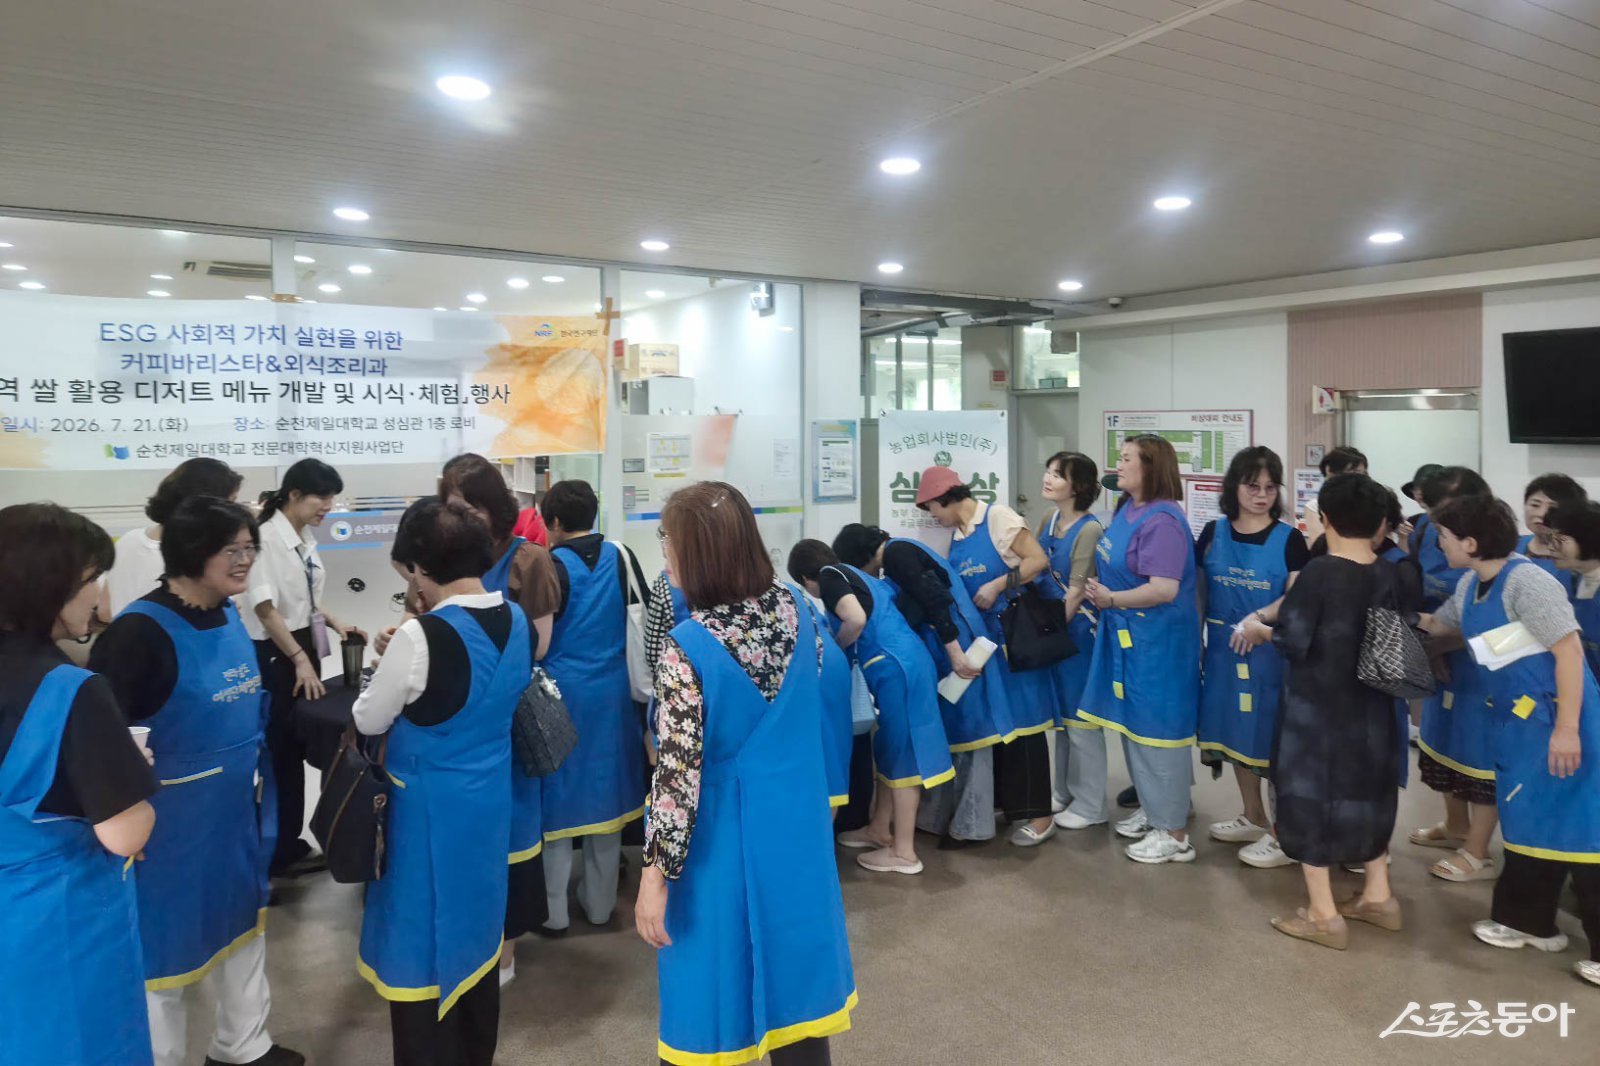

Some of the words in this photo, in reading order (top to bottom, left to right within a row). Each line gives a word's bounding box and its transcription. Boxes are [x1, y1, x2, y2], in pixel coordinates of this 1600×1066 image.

[99, 322, 157, 343] ESG
[167, 324, 236, 345] 사회적
[243, 324, 287, 346] 가치
[295, 326, 357, 349] 실현을
[363, 329, 404, 351] 위한
[120, 352, 388, 377] 커피바리스타&외식조리과
[30, 378, 58, 404] 쌀
[68, 379, 125, 404] 활용
[135, 380, 215, 404] 디저트
[223, 381, 272, 404] 메뉴
[279, 381, 326, 404] 개발
[334, 382, 354, 404] 및
[0, 416, 43, 433] 일시:
[50, 417, 105, 433] 2026.
[111, 418, 127, 433] 7.
[133, 416, 189, 433] 21.(화)
[232, 417, 270, 432] 장소:
[275, 417, 378, 432] 순천제일대학교
[383, 417, 425, 431] 성심관
[428, 417, 447, 431] 1층
[450, 417, 476, 431] 로비
[1107, 415, 1120, 427] 1F
[136, 443, 247, 459] 순천제일대학교
[251, 441, 404, 458] 전문대학혁신지원사업단
[889, 430, 998, 456] 농업회사법인(주)
[889, 471, 1000, 504] 심상
